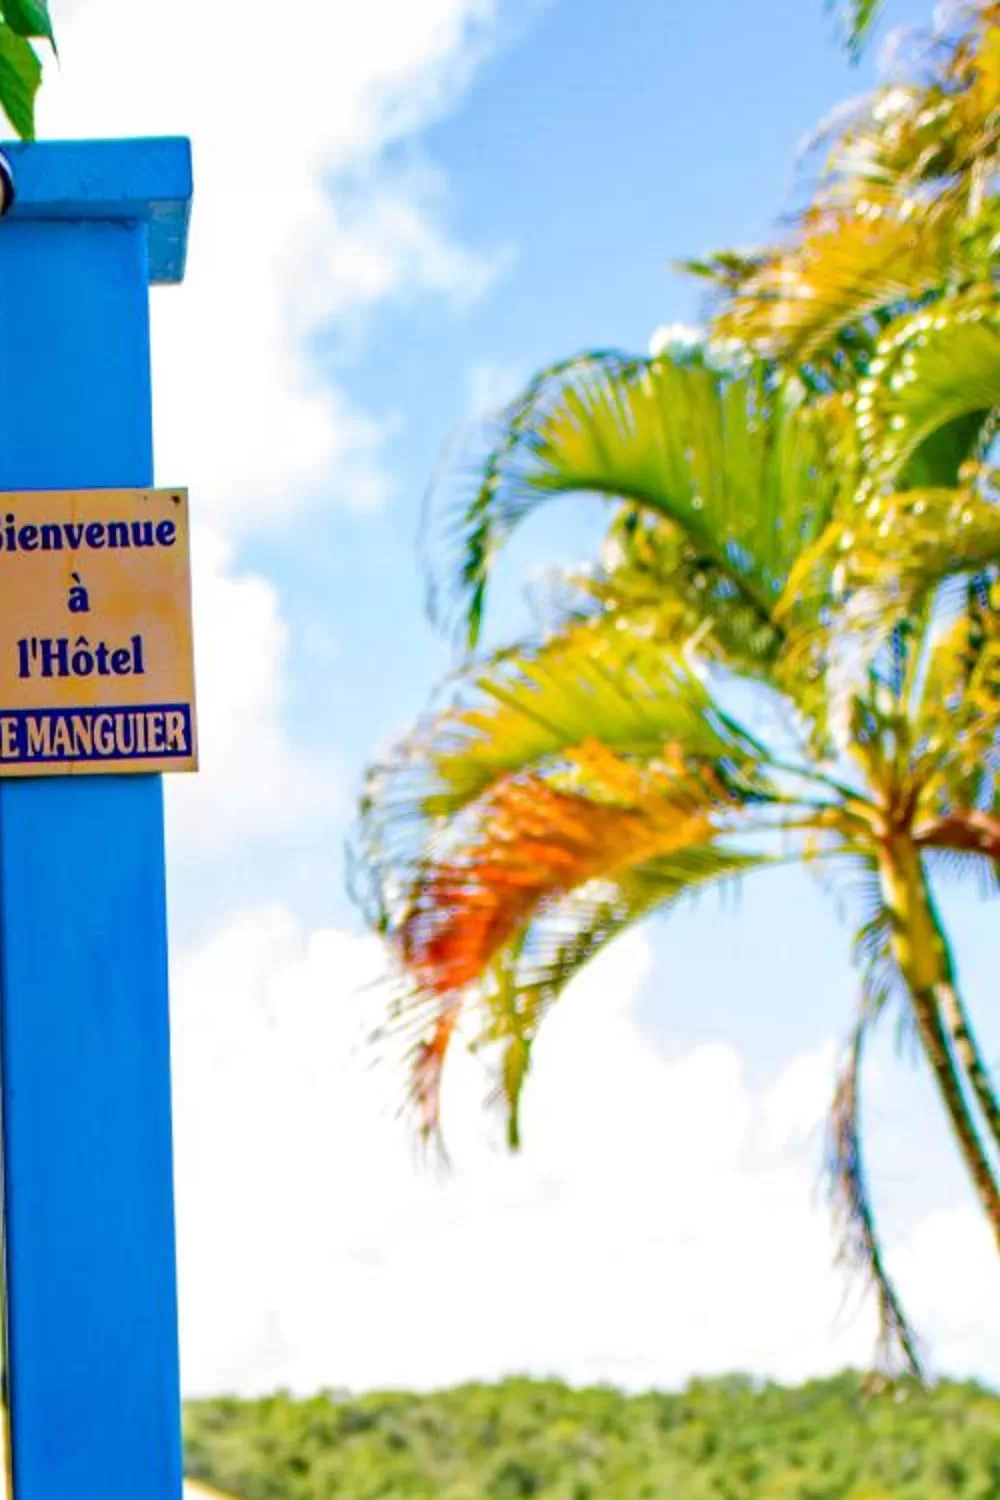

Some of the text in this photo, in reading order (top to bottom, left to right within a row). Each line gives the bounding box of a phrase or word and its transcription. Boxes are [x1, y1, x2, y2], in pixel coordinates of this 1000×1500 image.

[67, 572, 90, 613] à
[17, 635, 145, 678] l'Hôtel
[25, 710, 187, 757] MANGUIER
